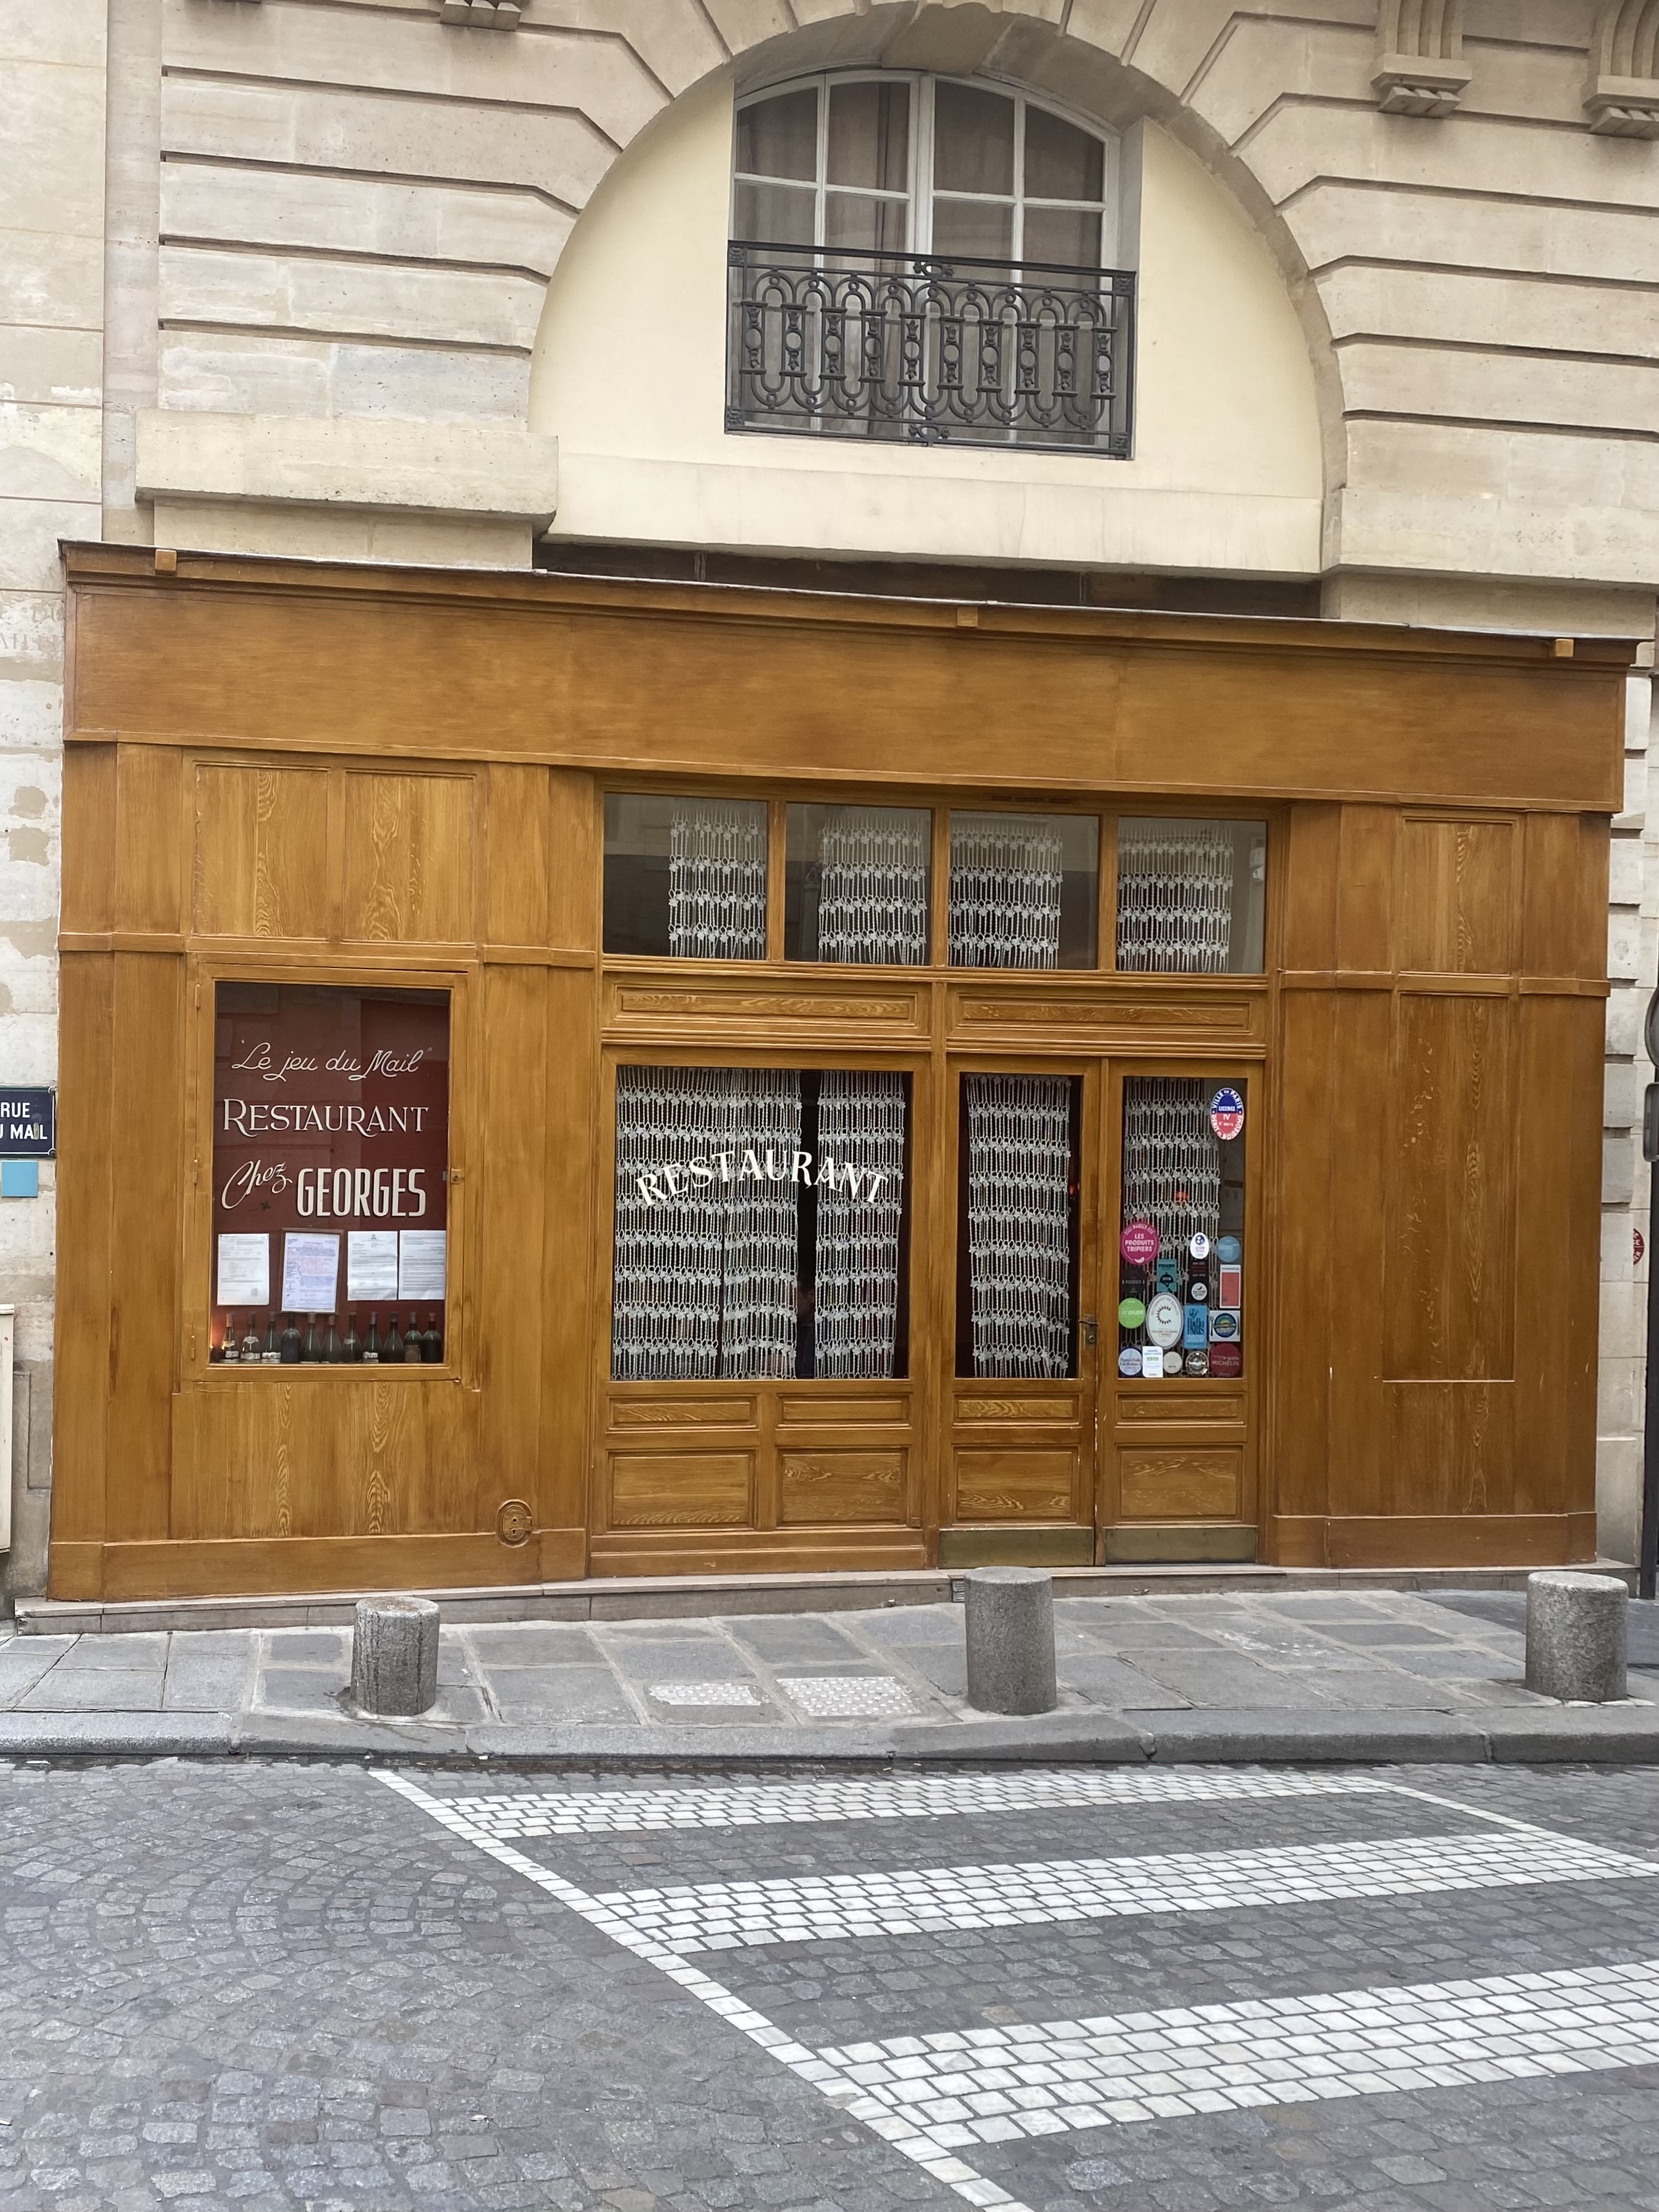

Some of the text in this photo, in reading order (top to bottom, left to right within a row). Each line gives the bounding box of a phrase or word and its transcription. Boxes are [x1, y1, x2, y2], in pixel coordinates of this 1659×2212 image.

[262, 1050, 318, 1082] jeu
[325, 1049, 360, 1071] du
[1, 1102, 30, 1118] RUE
[1212, 1091, 1224, 1108] VILLE
[1230, 1090, 1242, 1109] PARIS
[223, 1099, 429, 1137] RESTAURANT
[221, 1159, 426, 1217] Chez GEORGES
[635, 1148, 889, 1207] RESTAURANT
